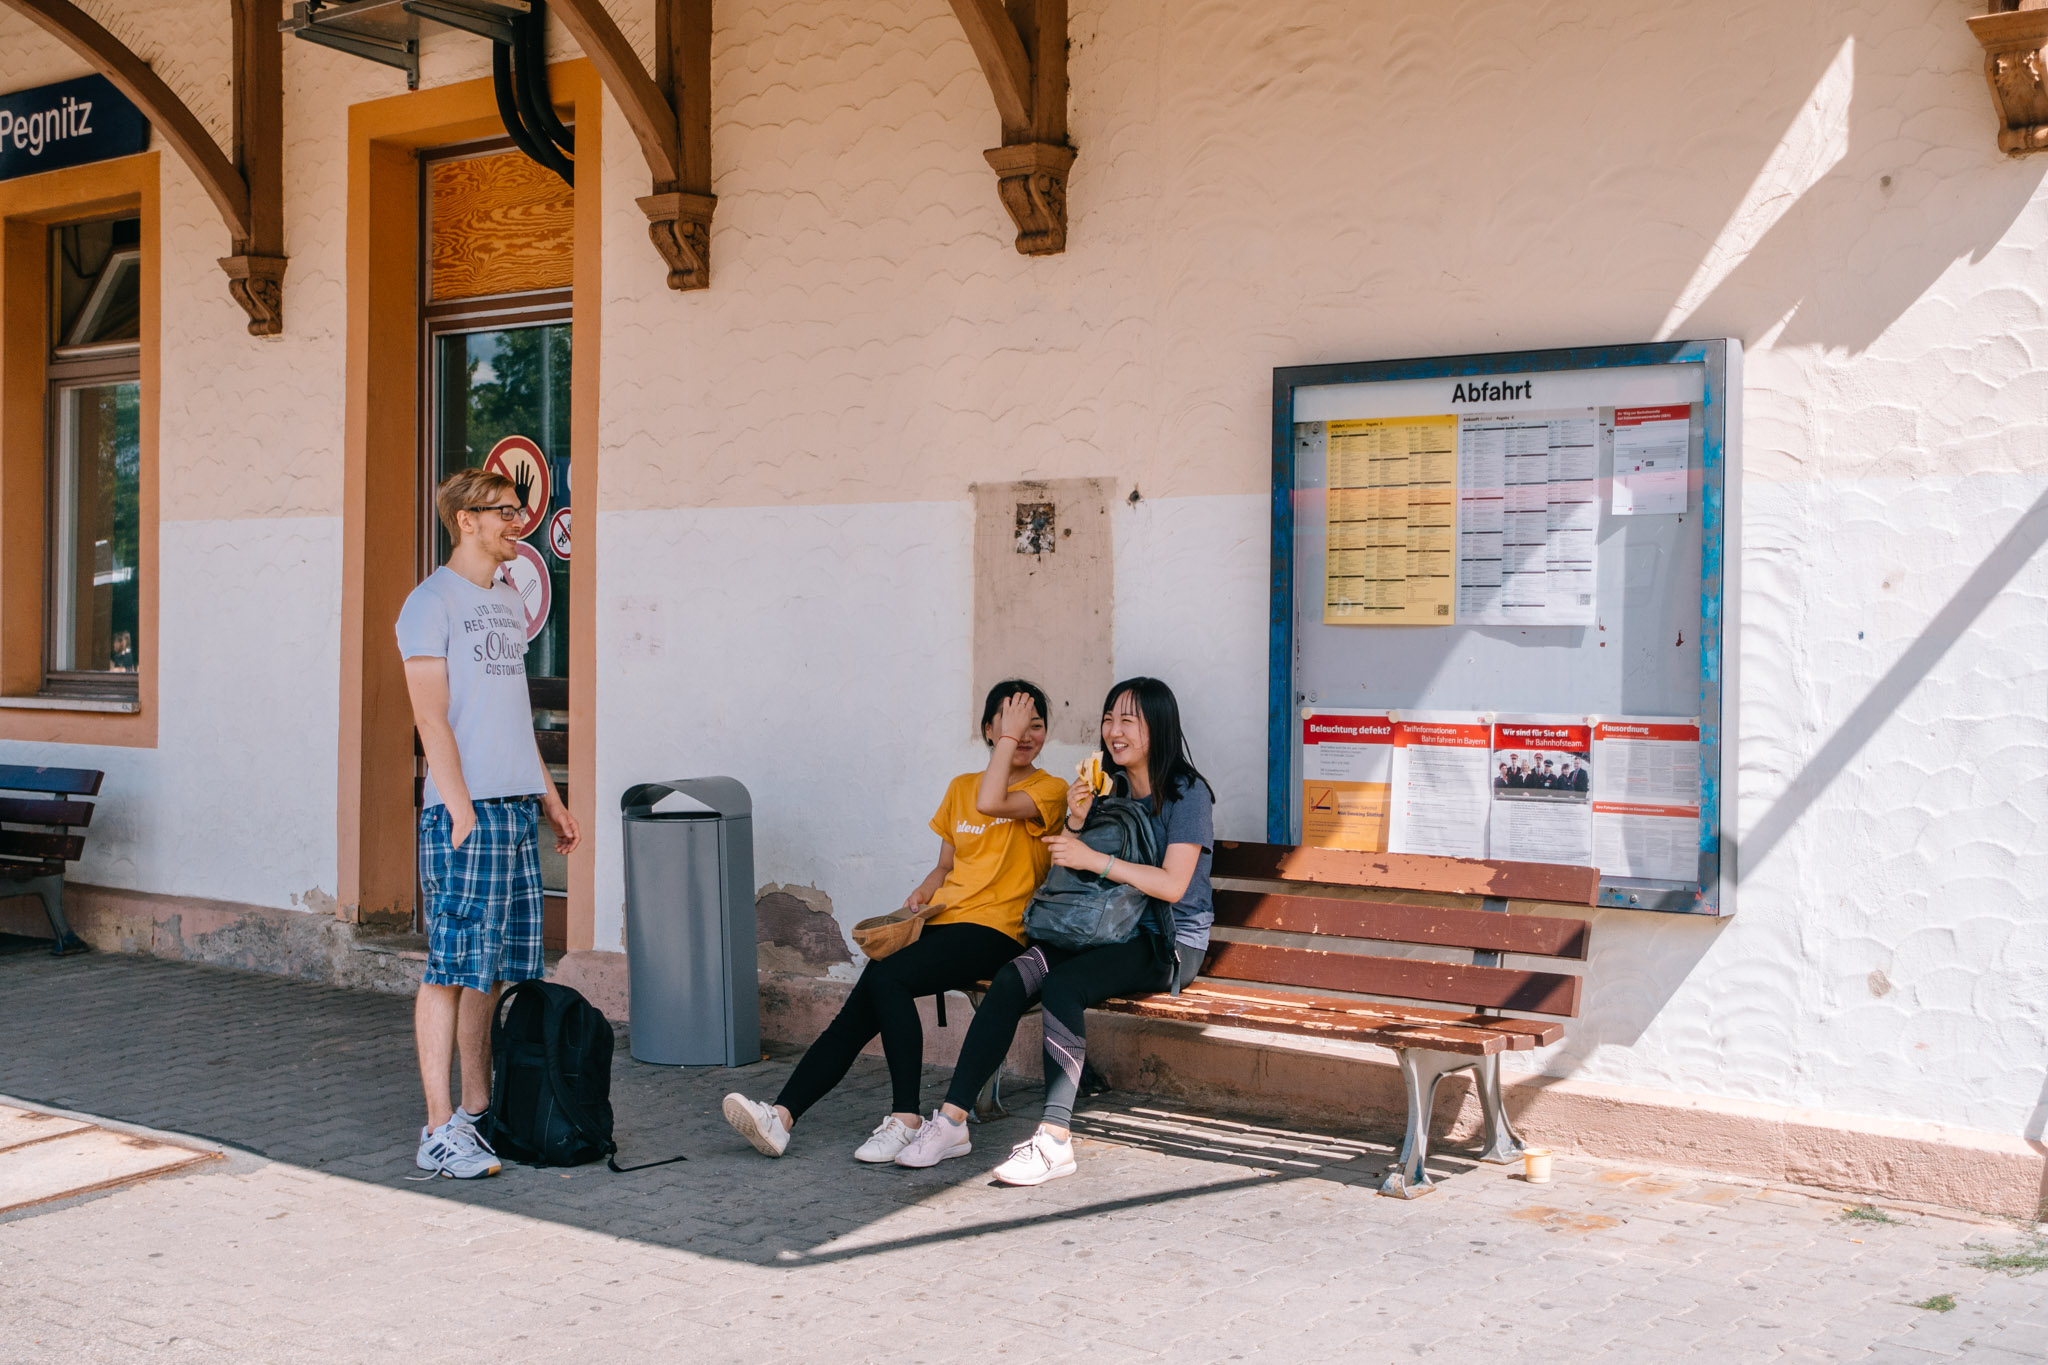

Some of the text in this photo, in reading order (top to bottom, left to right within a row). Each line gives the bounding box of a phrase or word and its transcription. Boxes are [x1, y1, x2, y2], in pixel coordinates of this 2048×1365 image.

[0, 97, 93, 156] Pegnitz
[1452, 380, 1532, 403] Abfahrt
[474, 604, 493, 617] LTD.
[464, 618, 521, 633] REG. TRADEM
[1310, 724, 1391, 736] Beleuchtung defekt?
[1403, 725, 1457, 735] Tarifinformationen
[1502, 728, 1569, 738] Wir sind für Sie da!
[1602, 724, 1649, 735] Hausordnung
[1421, 735, 1437, 743] Bahn
[1437, 736, 1456, 744] fahren
[1464, 737, 1486, 746] Bayern
[1525, 738, 1584, 748] Ihr Bahnhofsteam.
